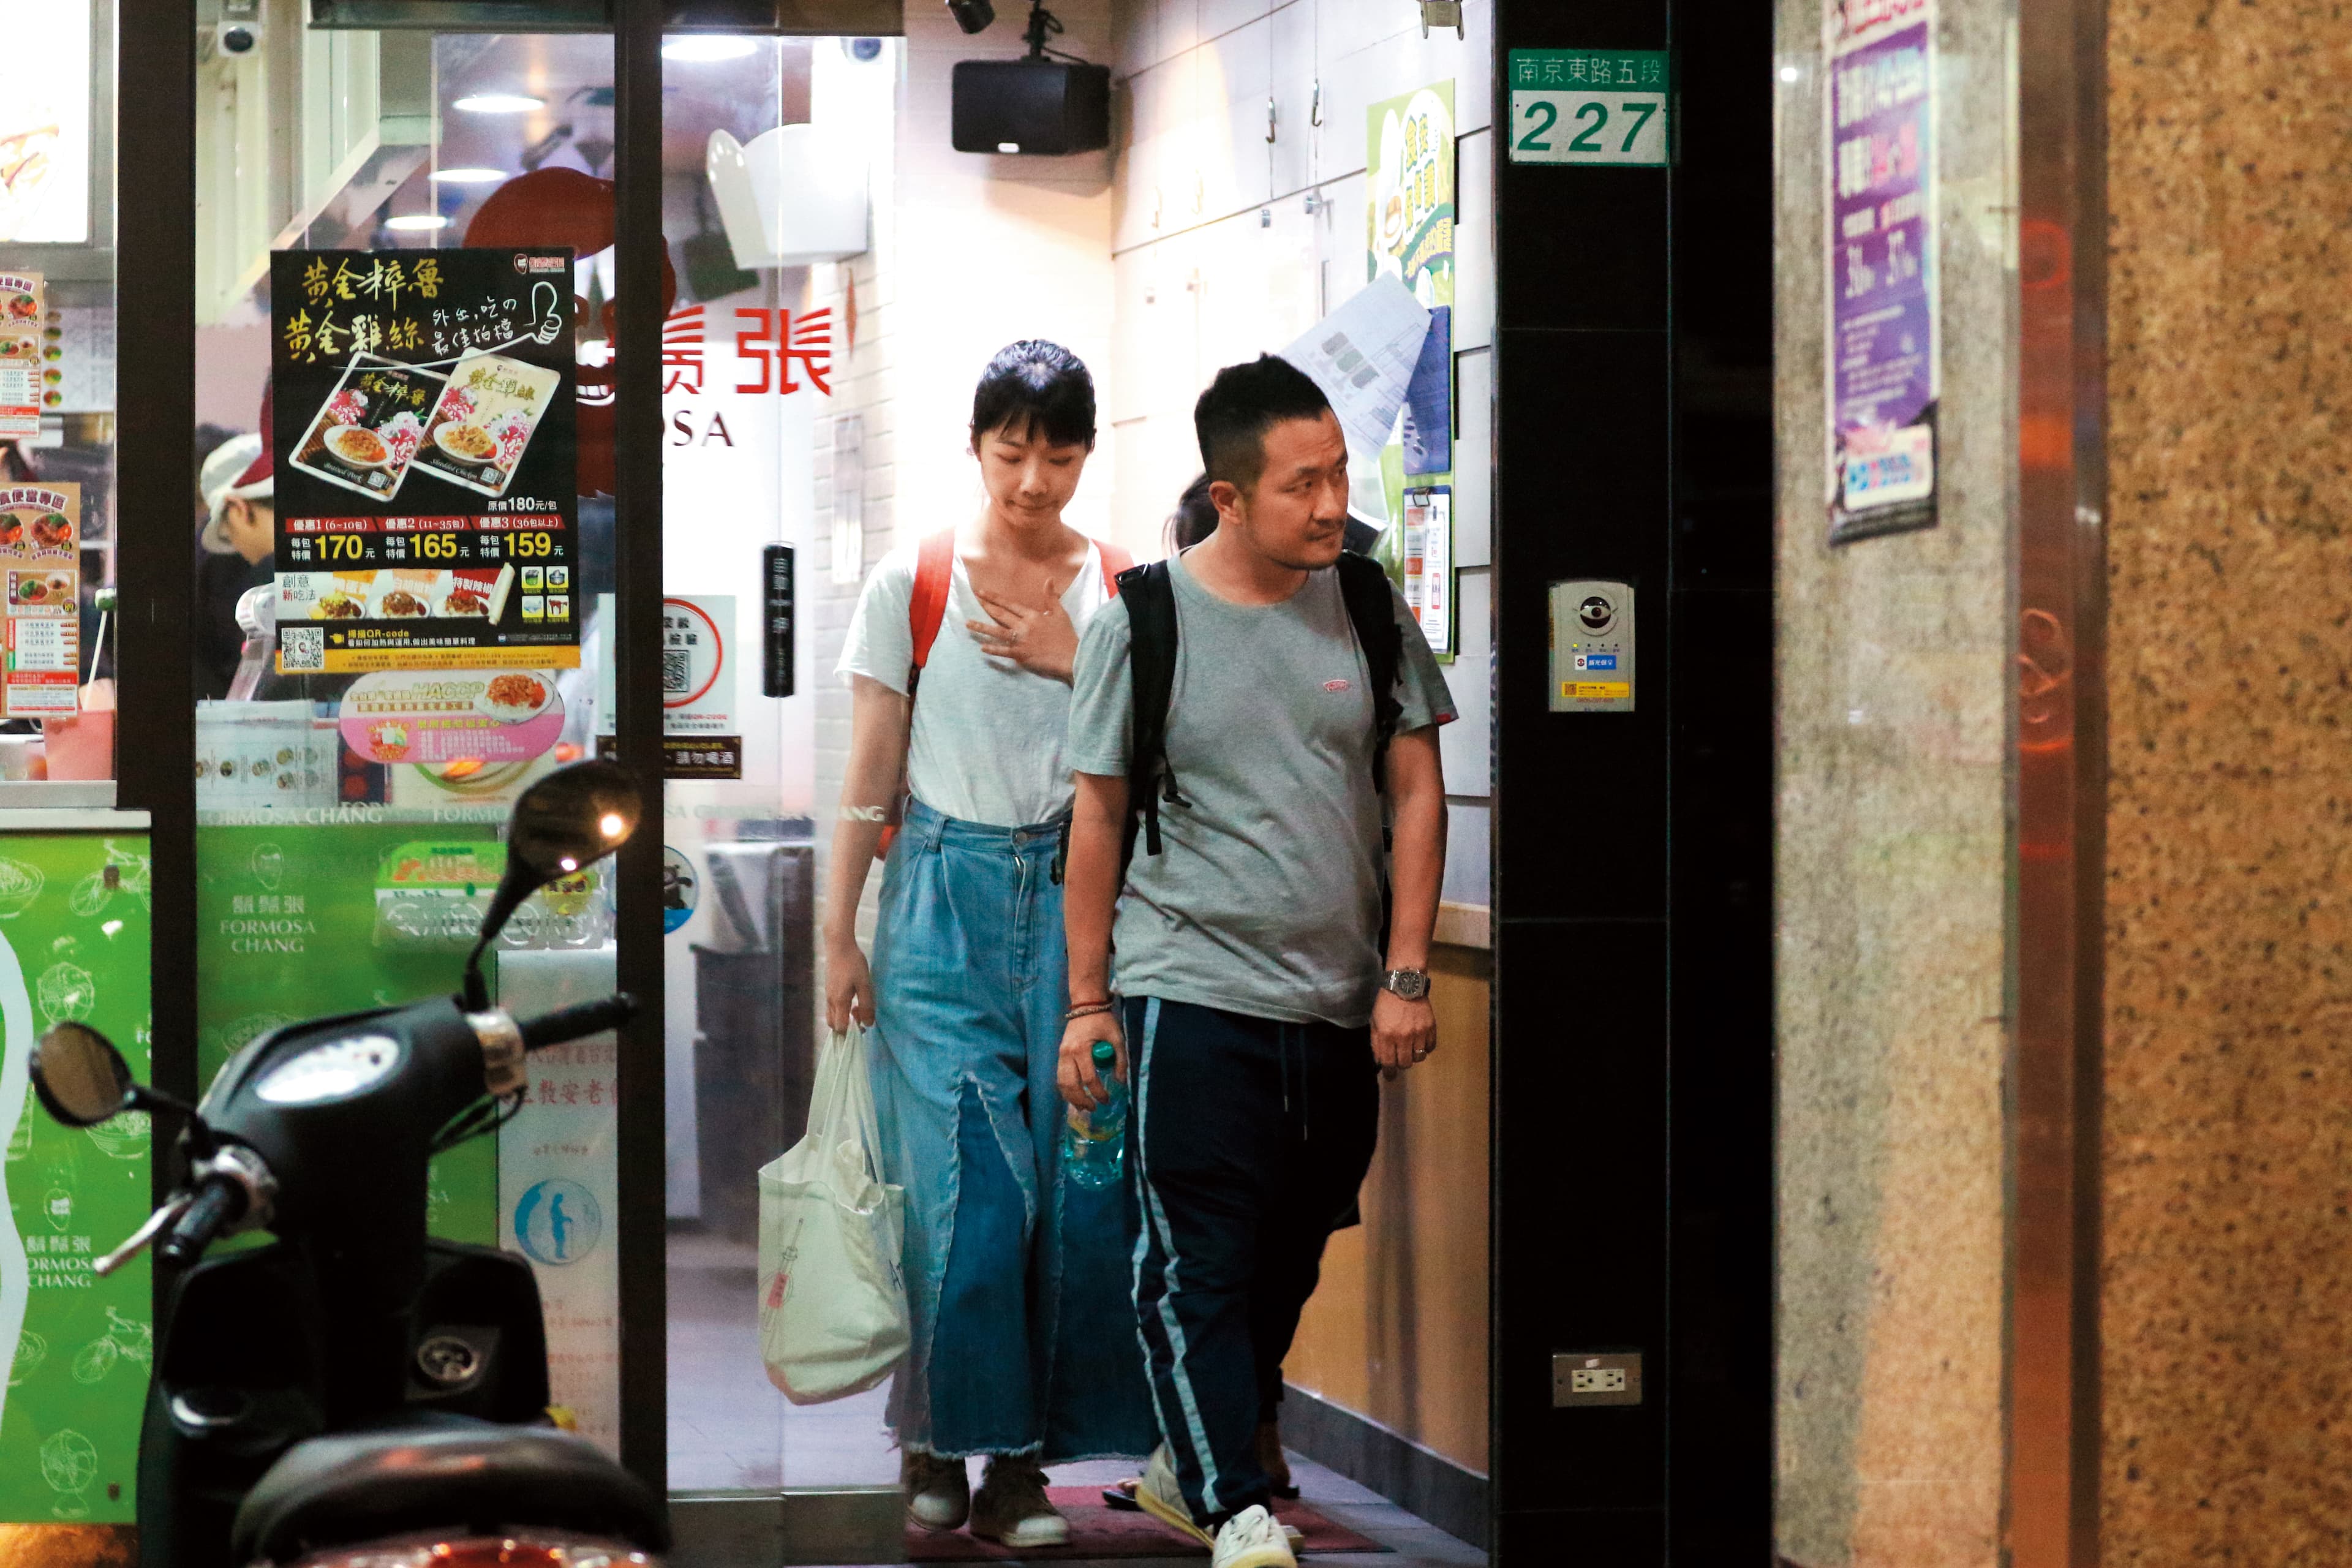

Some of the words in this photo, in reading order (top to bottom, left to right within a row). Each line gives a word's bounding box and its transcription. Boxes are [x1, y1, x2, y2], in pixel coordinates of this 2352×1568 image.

[1517, 58, 1661, 84] 南京東路五段
[1517, 100, 1657, 152] 227
[315, 534, 363, 560] 170
[365, 548, 375, 559] 元
[409, 533, 457, 559] 165
[459, 546, 470, 557] 元
[503, 532, 551, 557] 159
[554, 545, 564, 556] 元
[411, 681, 485, 699] HACCP
[198, 806, 301, 825] ORMOSA
[306, 807, 383, 824] CHANG
[433, 807, 510, 822] FORMO
[219, 919, 316, 935] FORMOSA
[231, 937, 304, 953] CHANG
[28, 1256, 91, 1272] ORMOS
